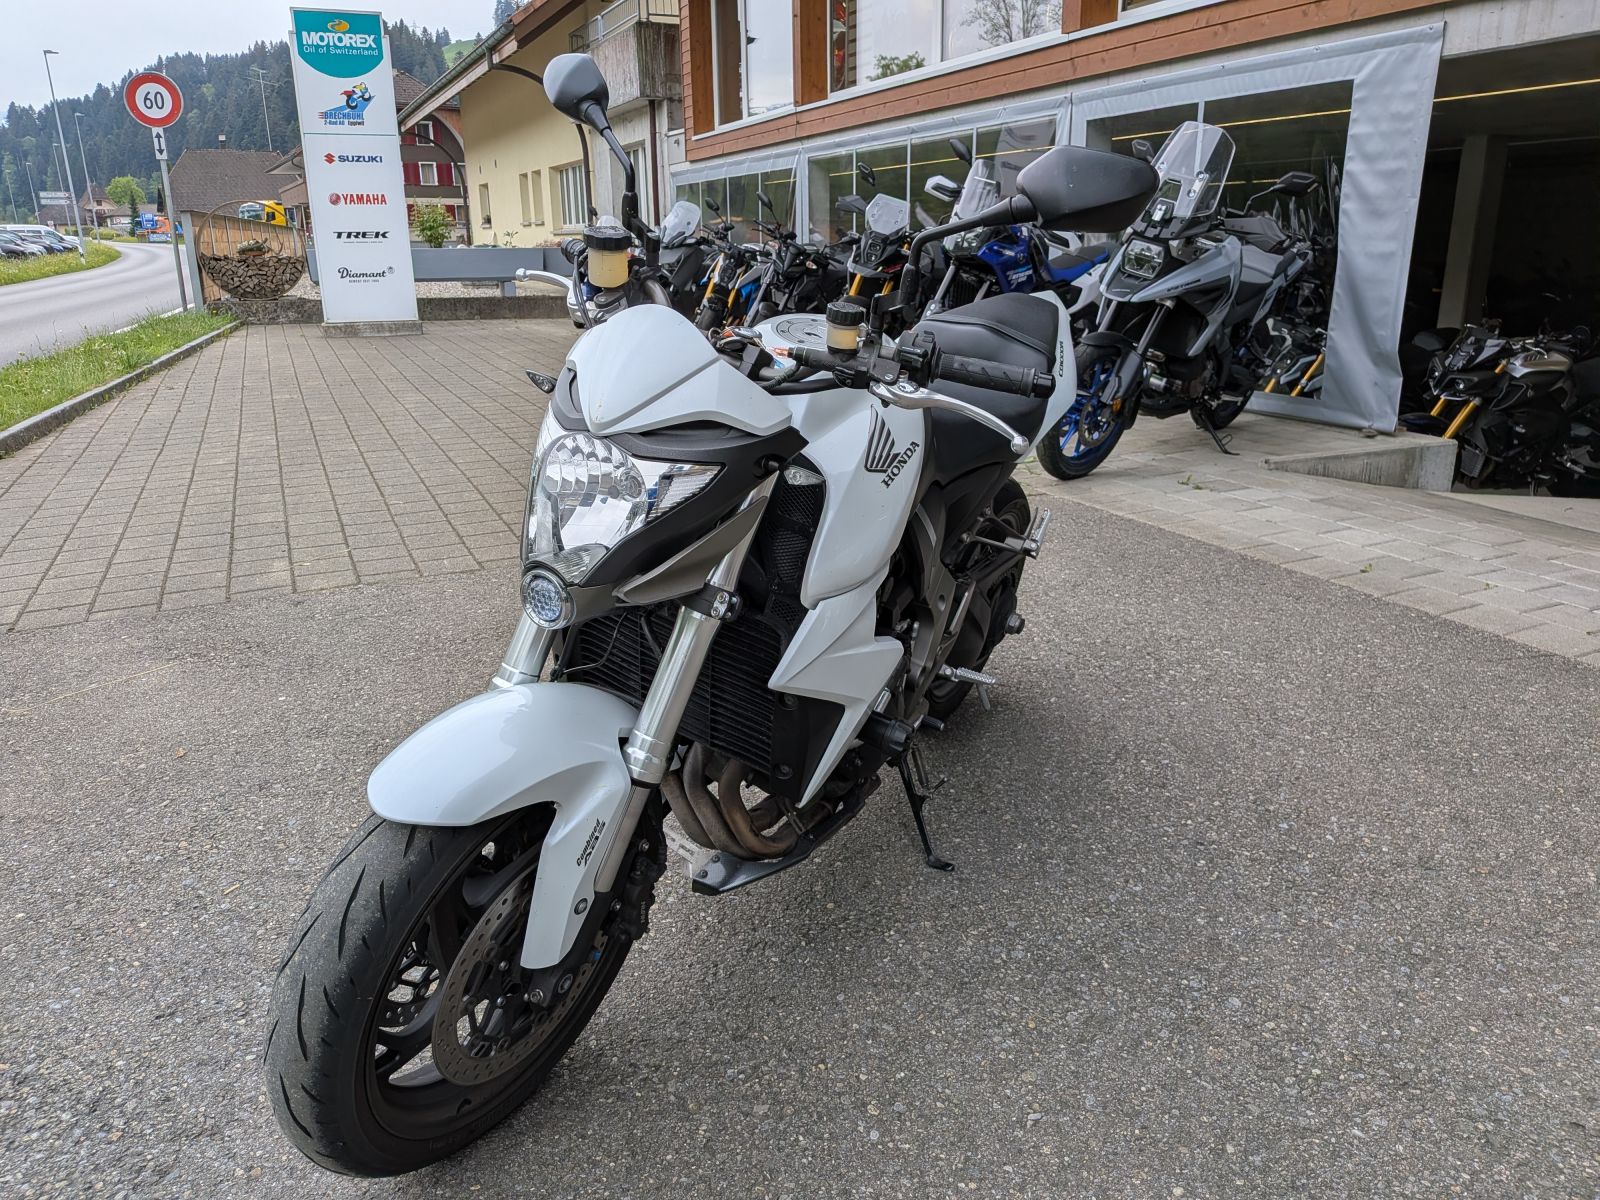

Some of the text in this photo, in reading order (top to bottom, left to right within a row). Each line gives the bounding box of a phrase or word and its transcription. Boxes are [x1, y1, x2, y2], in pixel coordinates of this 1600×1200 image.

[302, 31, 377, 48] MOTOREX
[304, 45, 378, 56] Oil of Switzerland
[143, 91, 165, 110] 60
[337, 154, 383, 164] SUZUKI
[342, 193, 388, 206] YAMAHA
[332, 231, 390, 239] TREK
[337, 266, 388, 279] Diamant
[880, 440, 920, 489] HONDA
[576, 818, 601, 867] Combined
